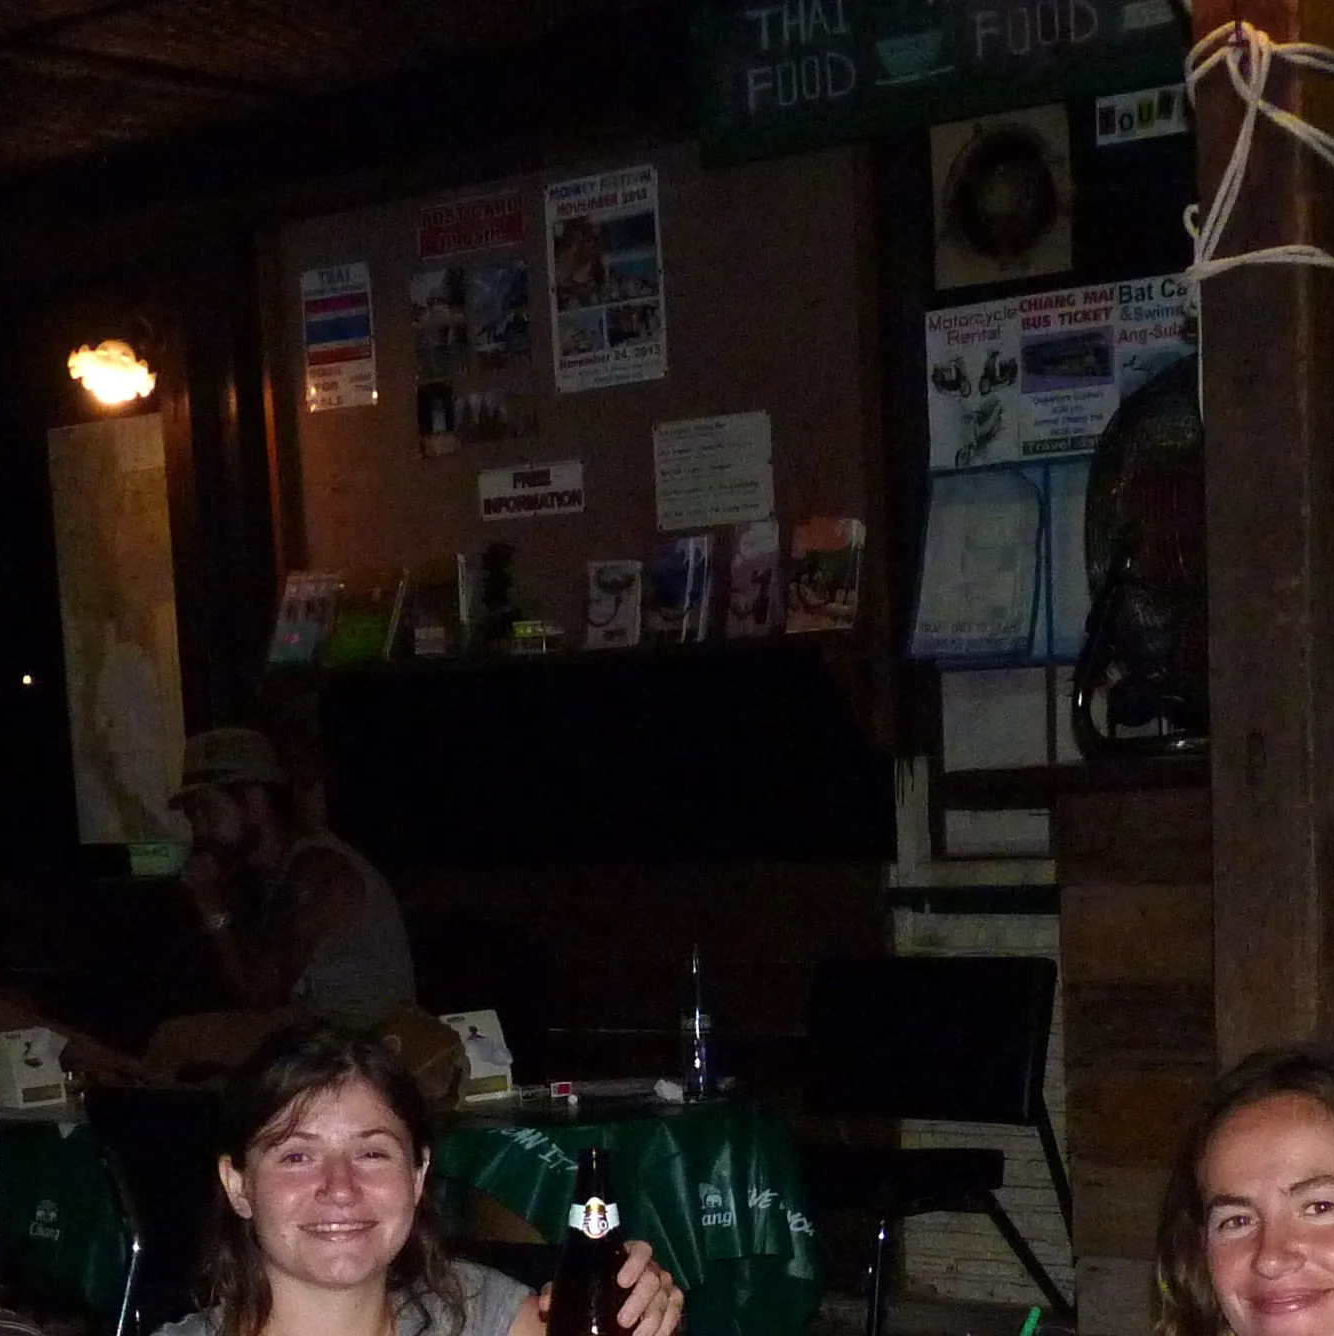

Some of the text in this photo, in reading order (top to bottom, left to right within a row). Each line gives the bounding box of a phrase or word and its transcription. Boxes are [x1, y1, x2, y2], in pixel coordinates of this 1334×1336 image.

[743, 0, 851, 52] THAI
[975, 0, 1100, 60] FOOD
[746, 51, 858, 117] FOOD
[1019, 290, 1115, 314] CHIANG MAI
[1118, 277, 1189, 306] Bat Ca
[928, 306, 1017, 333] Motorcycle
[1021, 306, 1113, 331] BUS TICKET
[947, 327, 1002, 346] Rental
[512, 468, 552, 490] FREE
[483, 488, 583, 515] INFORMATION
[701, 1210, 733, 1228] ang
